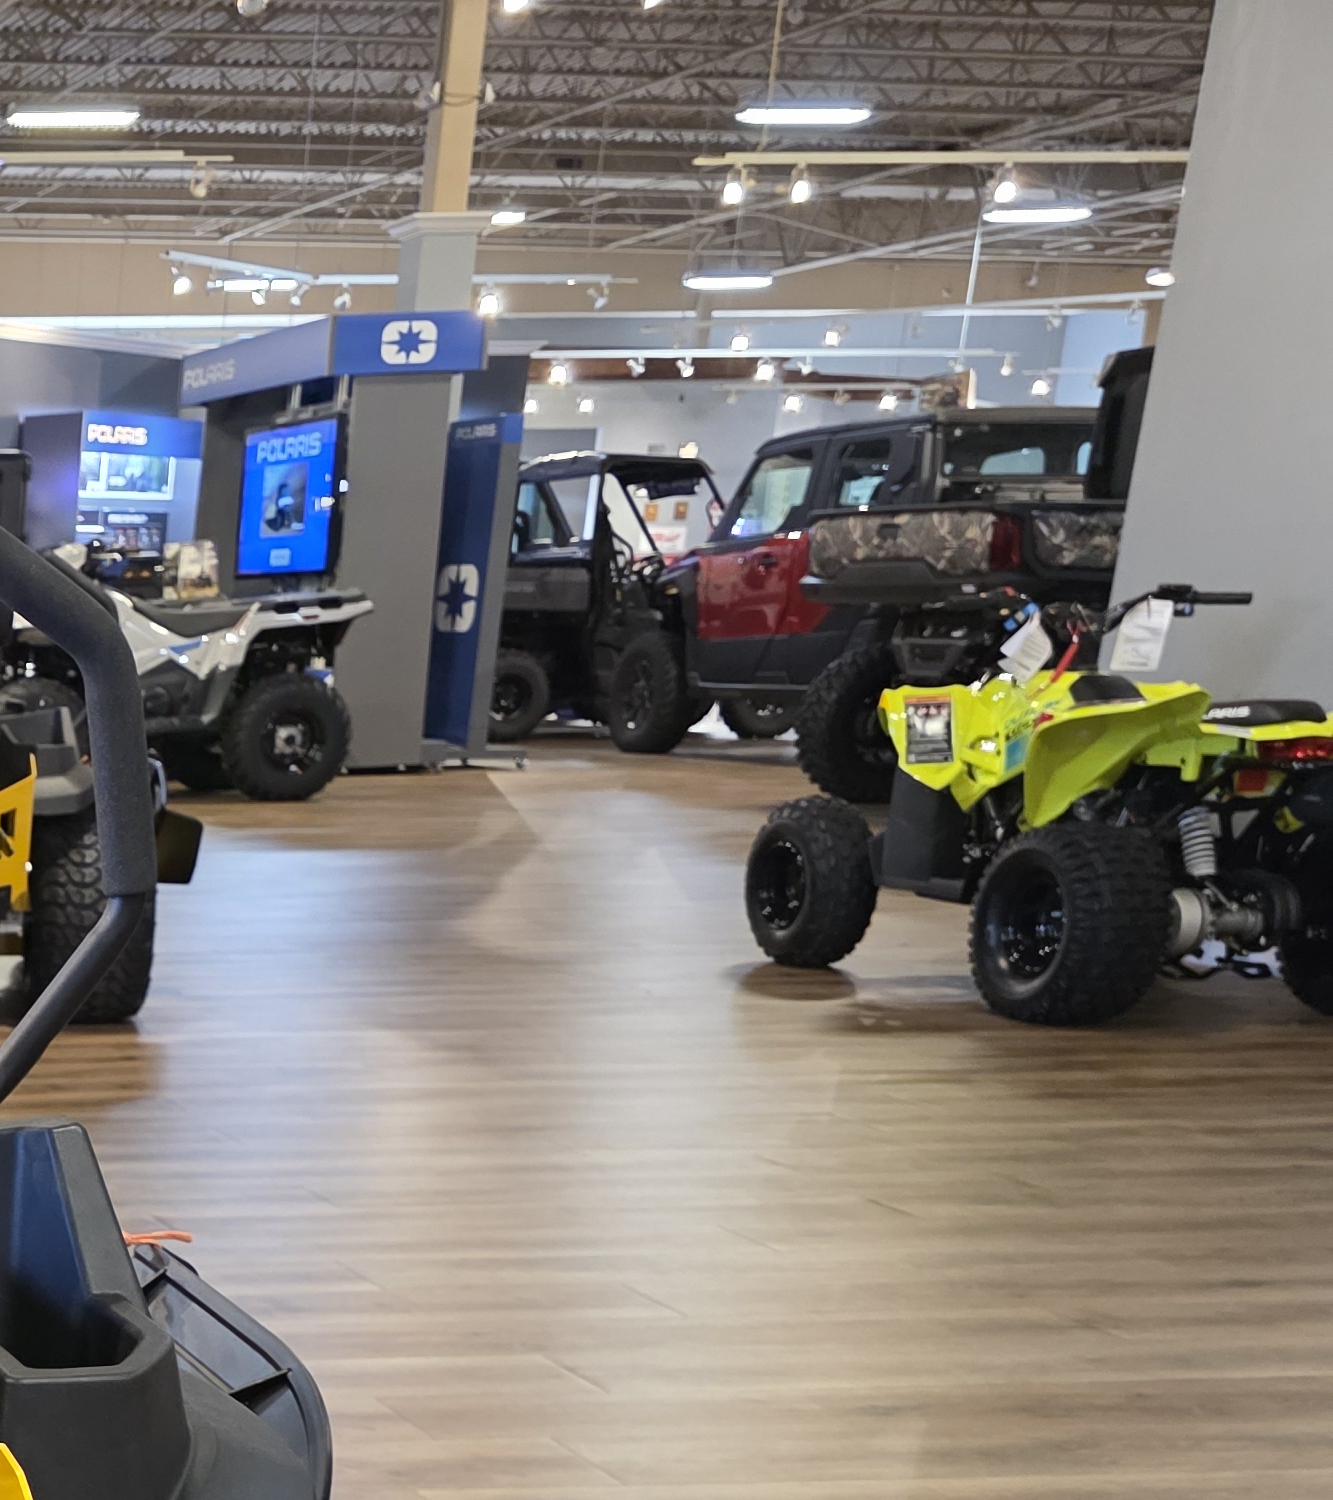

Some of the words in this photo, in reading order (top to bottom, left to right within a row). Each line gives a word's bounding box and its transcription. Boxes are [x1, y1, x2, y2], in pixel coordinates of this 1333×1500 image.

[183, 358, 236, 391] POLARIS
[87, 423, 148, 446] POLARIS
[255, 431, 323, 464] POLARIS
